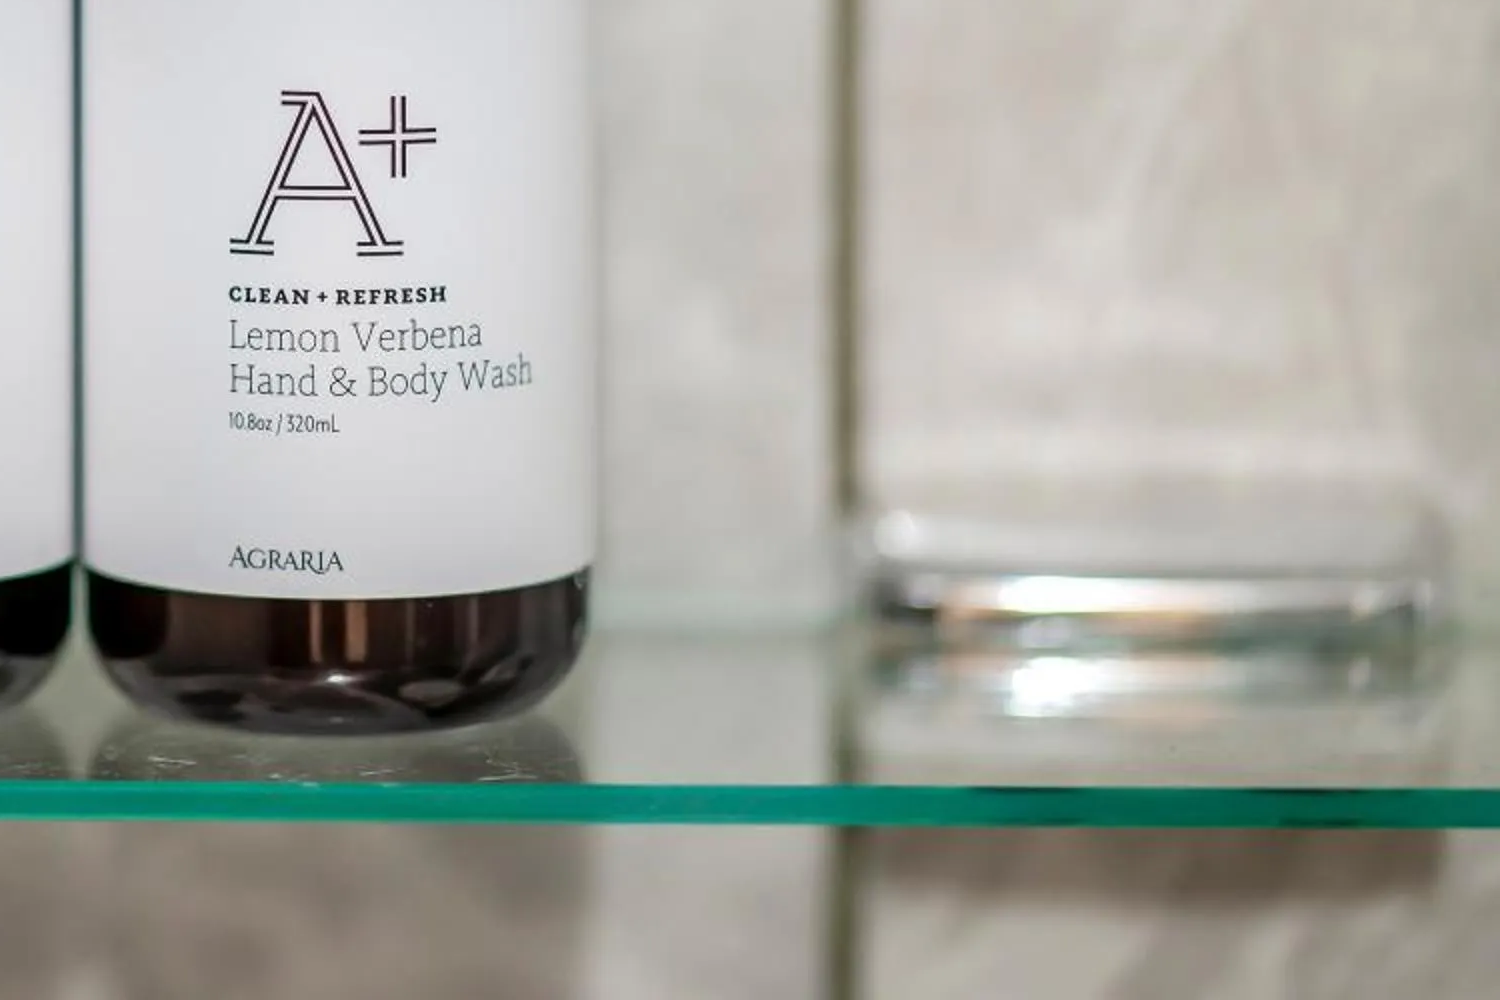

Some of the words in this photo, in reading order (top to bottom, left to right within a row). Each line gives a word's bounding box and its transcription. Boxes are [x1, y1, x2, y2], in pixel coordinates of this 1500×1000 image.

[228, 285, 310, 306] CLEAN
[335, 285, 447, 306] REFRESH
[229, 319, 341, 353] Lemon
[351, 318, 483, 352] Verbena
[229, 362, 318, 398] Hand
[328, 365, 357, 398] &
[367, 362, 448, 403] Body
[457, 351, 533, 392] Wash
[228, 411, 273, 432] 10.8oz
[286, 413, 340, 434] 320mL
[228, 545, 345, 576] AGRARIA
